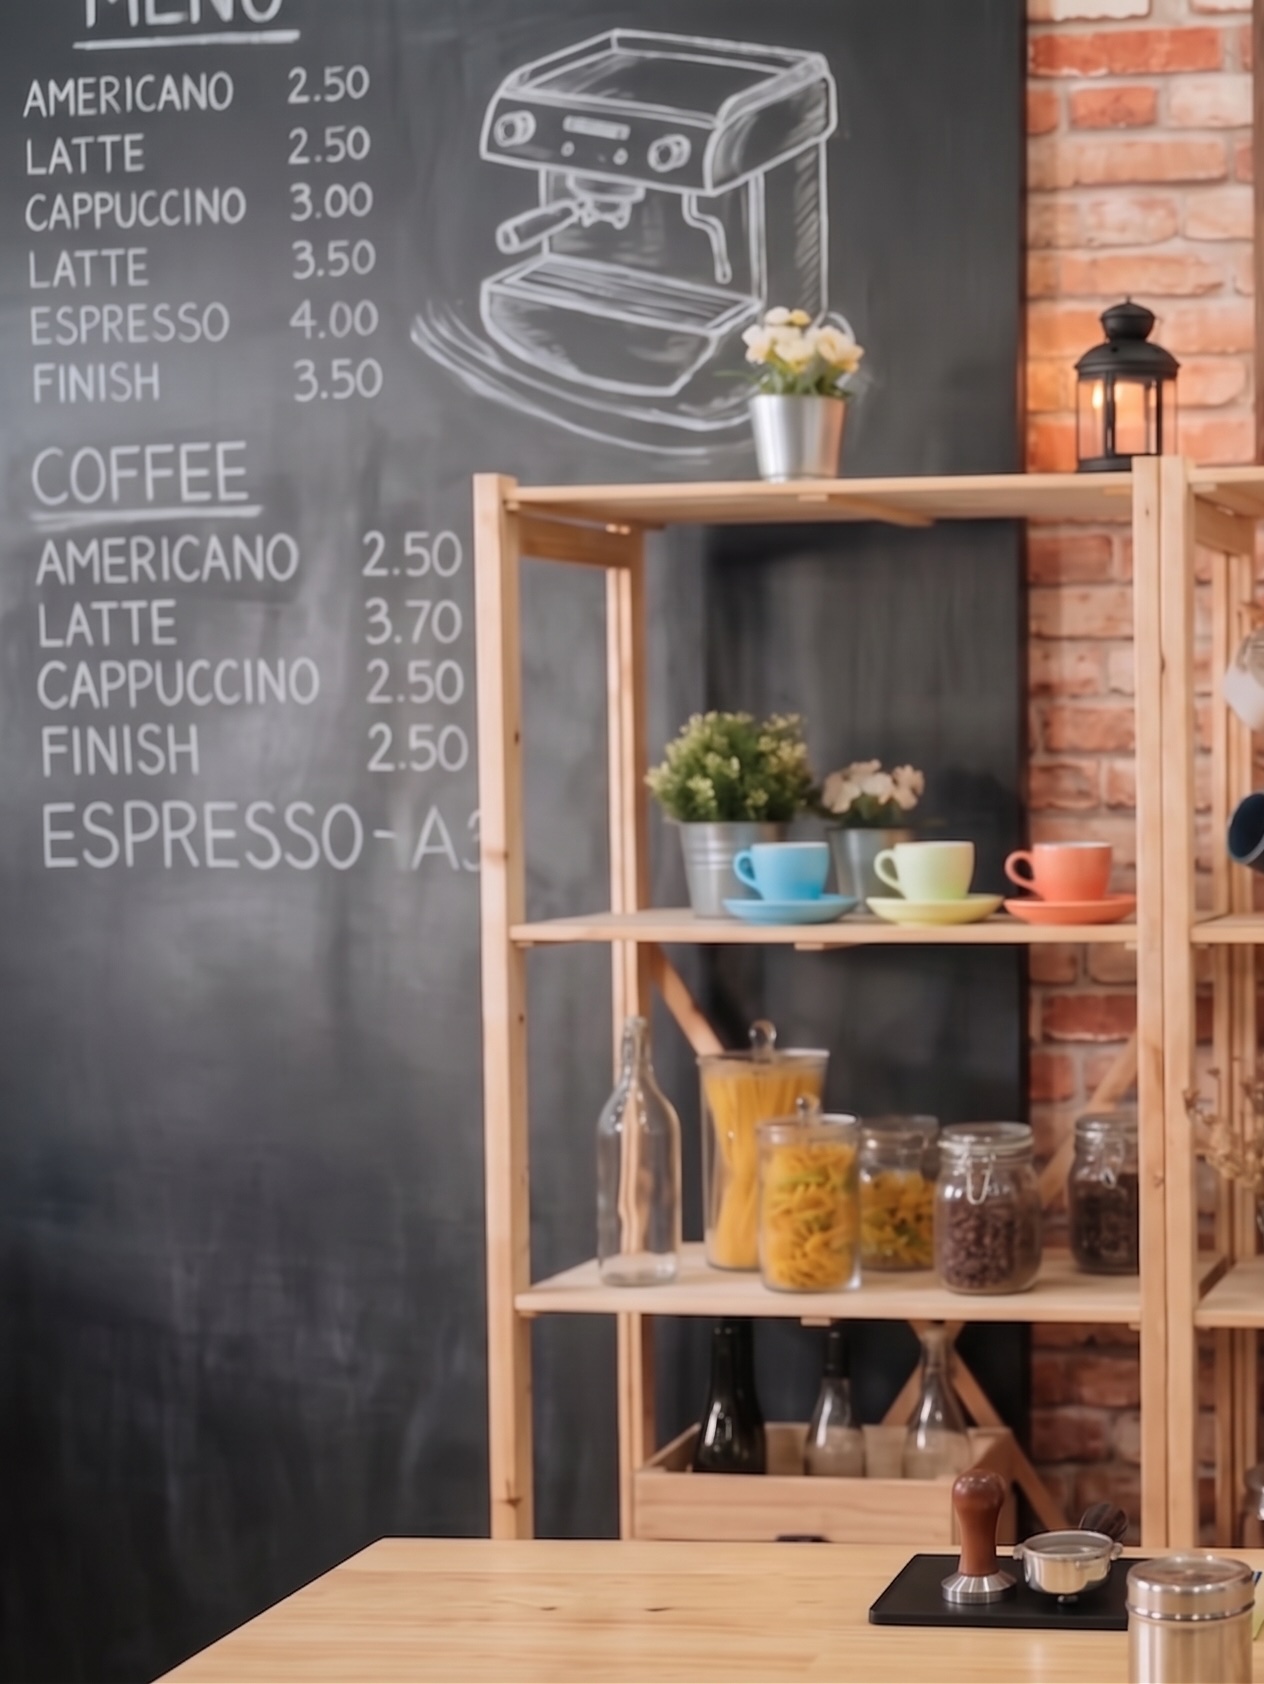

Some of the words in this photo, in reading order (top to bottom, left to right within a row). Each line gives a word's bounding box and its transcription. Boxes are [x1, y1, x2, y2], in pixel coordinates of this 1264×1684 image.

[23, 71, 234, 118] AMERICANO
[287, 65, 370, 103] 2.50
[25, 133, 145, 175] LATTE
[287, 126, 371, 165] 2.50
[24, 187, 247, 232] CAPPUCCINO
[288, 182, 374, 221] 3.00
[28, 247, 149, 289] LATTE
[290, 240, 376, 279] 3.50
[30, 302, 231, 346] ESPRESSO
[288, 299, 379, 339] 4.00
[32, 361, 160, 404] FINISH
[292, 358, 383, 402] 3.50
[31, 440, 249, 504] COFFEE
[35, 532, 301, 586] AMERICANO
[361, 530, 464, 578] 2.50
[37, 598, 179, 648] LATTE
[364, 597, 464, 645] 3.70
[37, 657, 320, 709] CAPPUCCINO
[365, 659, 465, 705] 2.50
[41, 722, 201, 777] FINISH
[366, 722, 470, 773] 2.50
